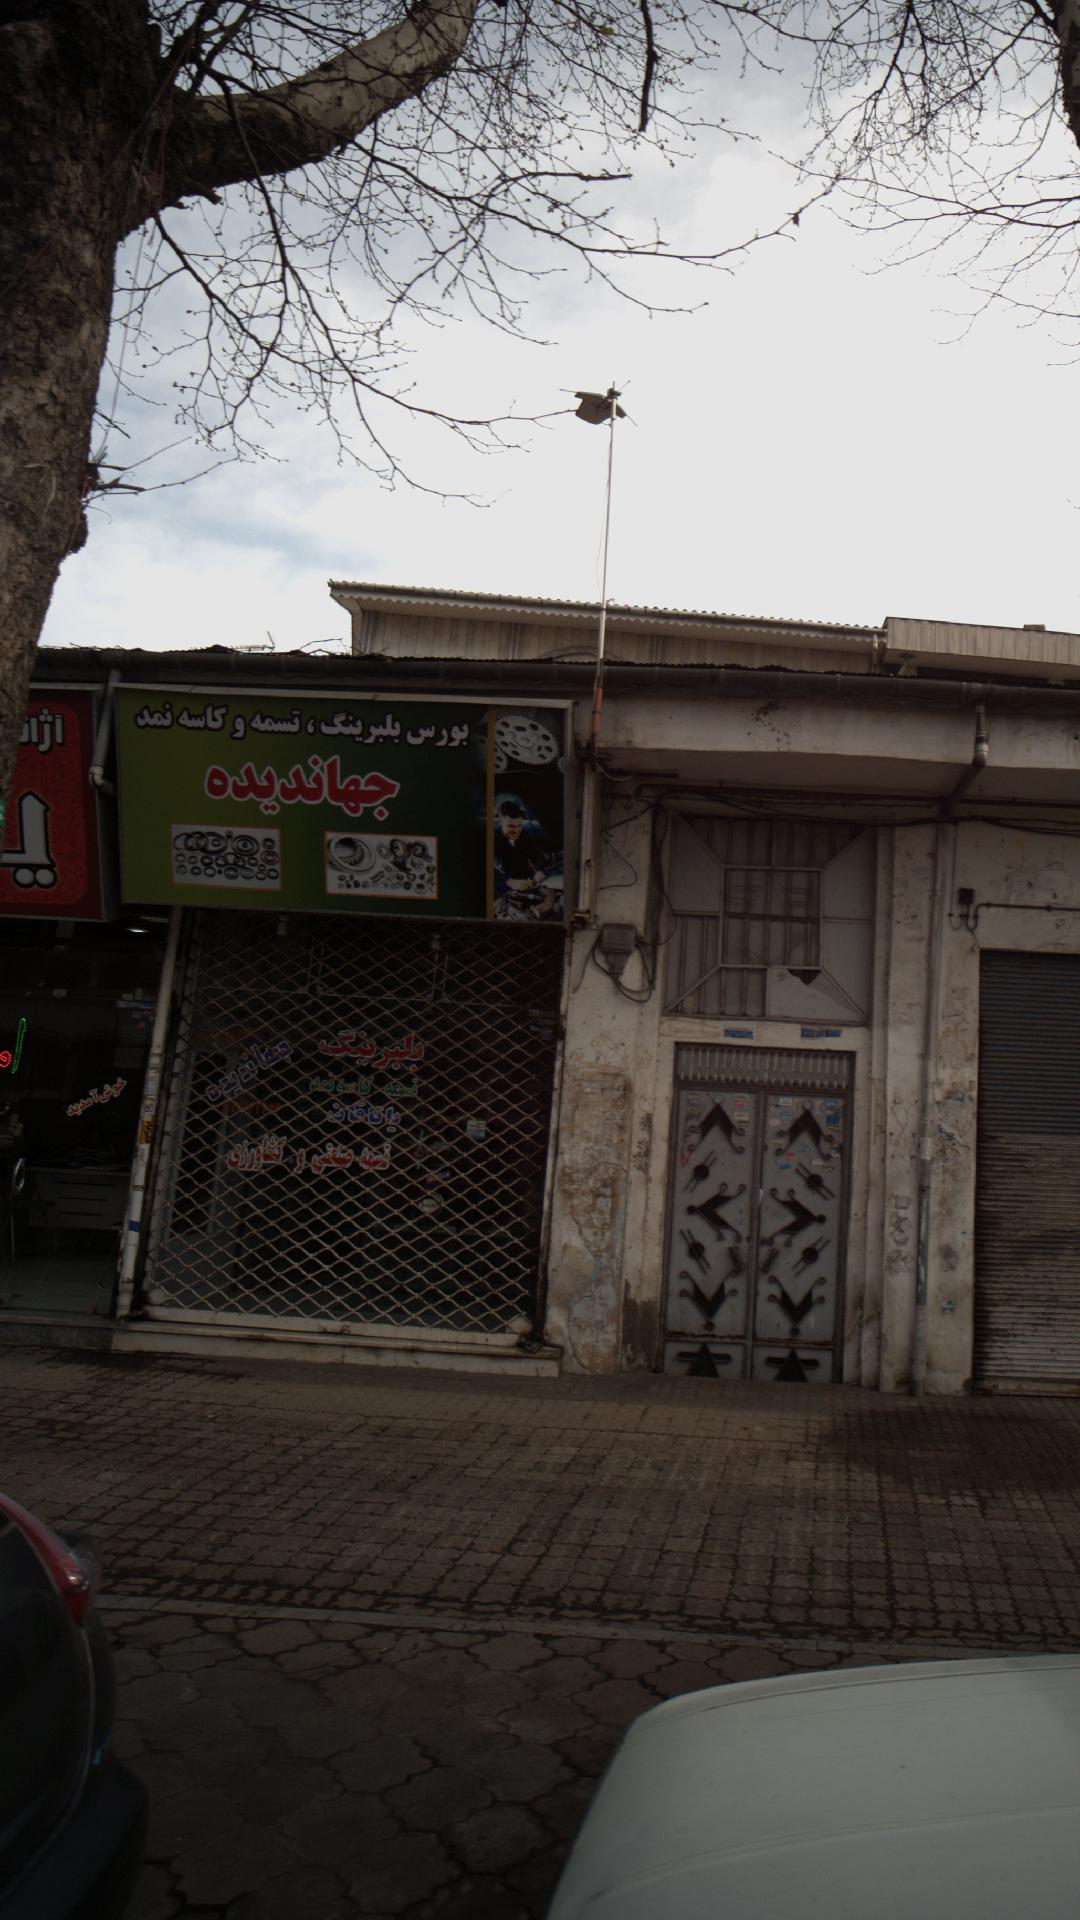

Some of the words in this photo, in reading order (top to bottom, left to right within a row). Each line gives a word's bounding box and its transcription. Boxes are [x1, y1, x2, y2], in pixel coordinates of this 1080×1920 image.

[135, 702, 173, 728] نمد
[176, 703, 228, 731] کاسه
[231, 714, 247, 739] و
[249, 709, 301, 735] تسمه
[405, 719, 470, 747] بورس
[204, 754, 400, 821] جهاندیده
[206, 1040, 294, 1102] جهاندیده
